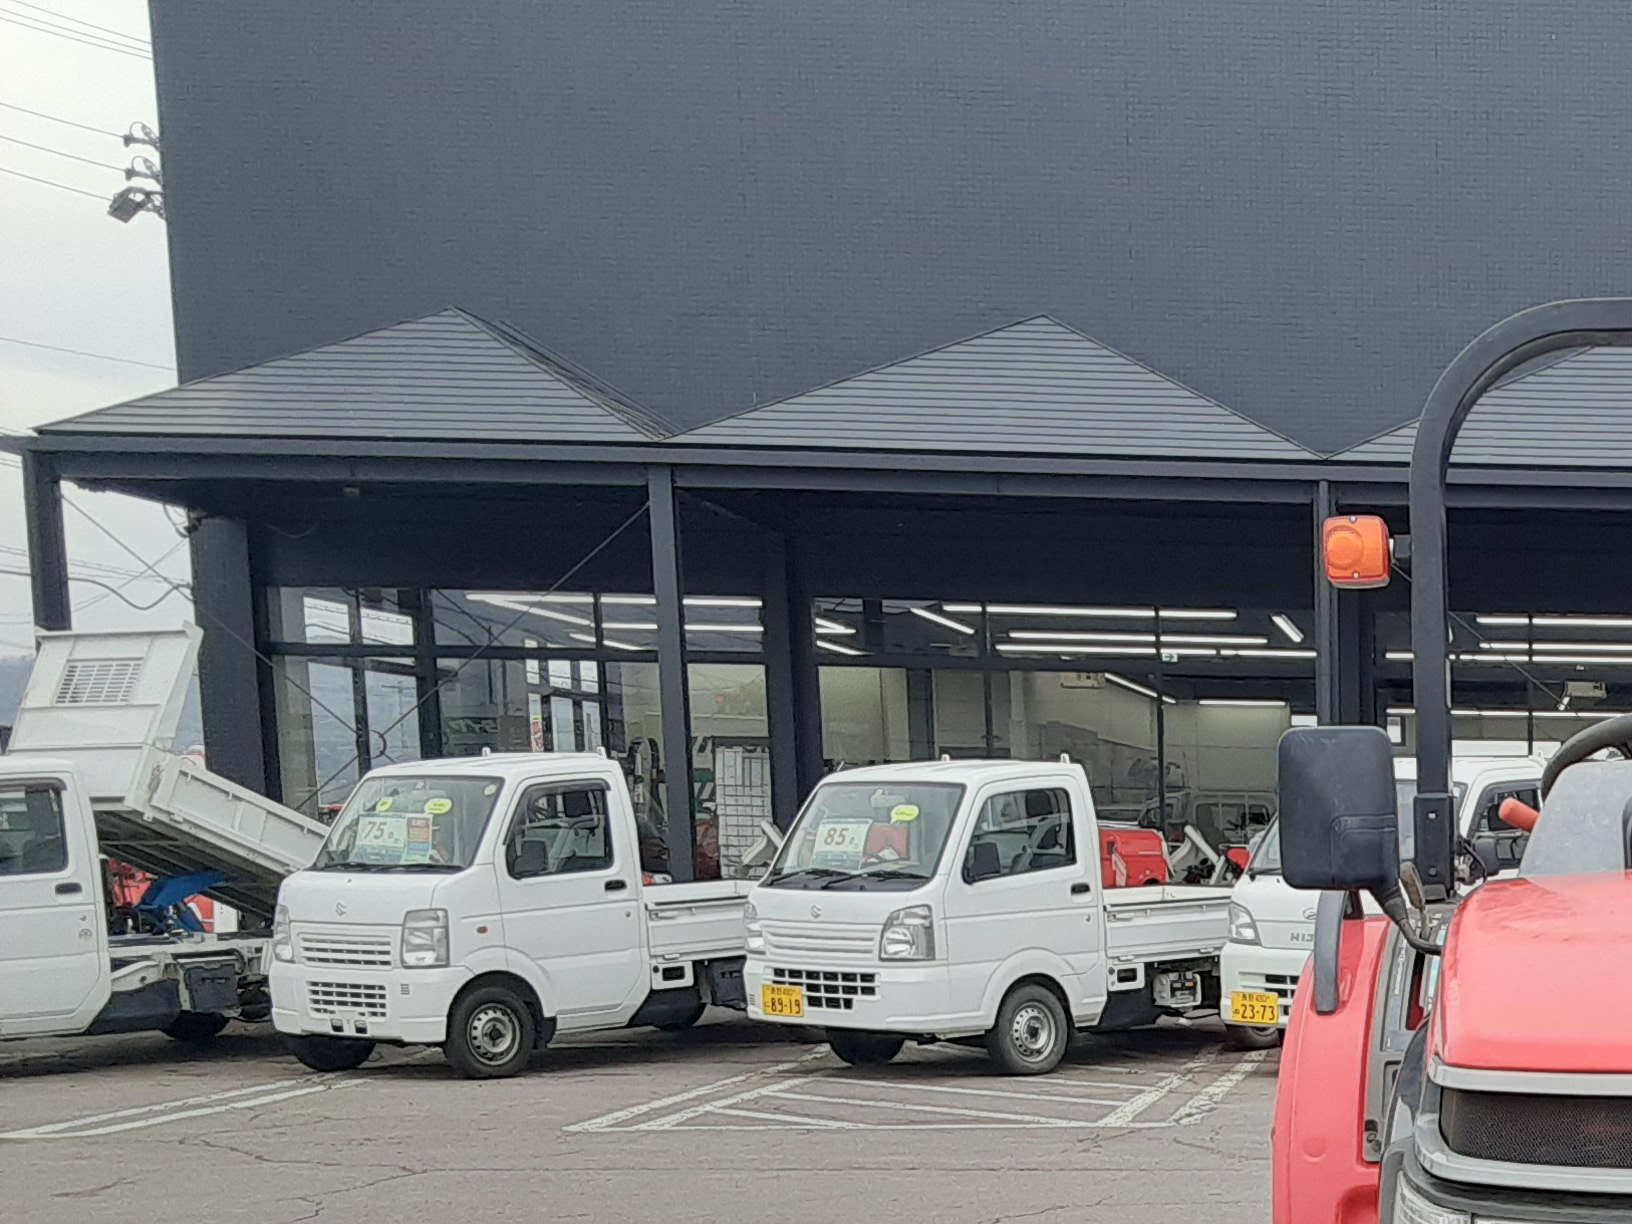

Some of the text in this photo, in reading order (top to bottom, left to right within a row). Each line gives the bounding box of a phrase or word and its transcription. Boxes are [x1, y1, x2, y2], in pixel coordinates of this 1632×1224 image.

[1290, 932, 1314, 942] HIJ
[771, 997, 801, 1014] 89-19
[1240, 1003, 1275, 1021] 23-73
